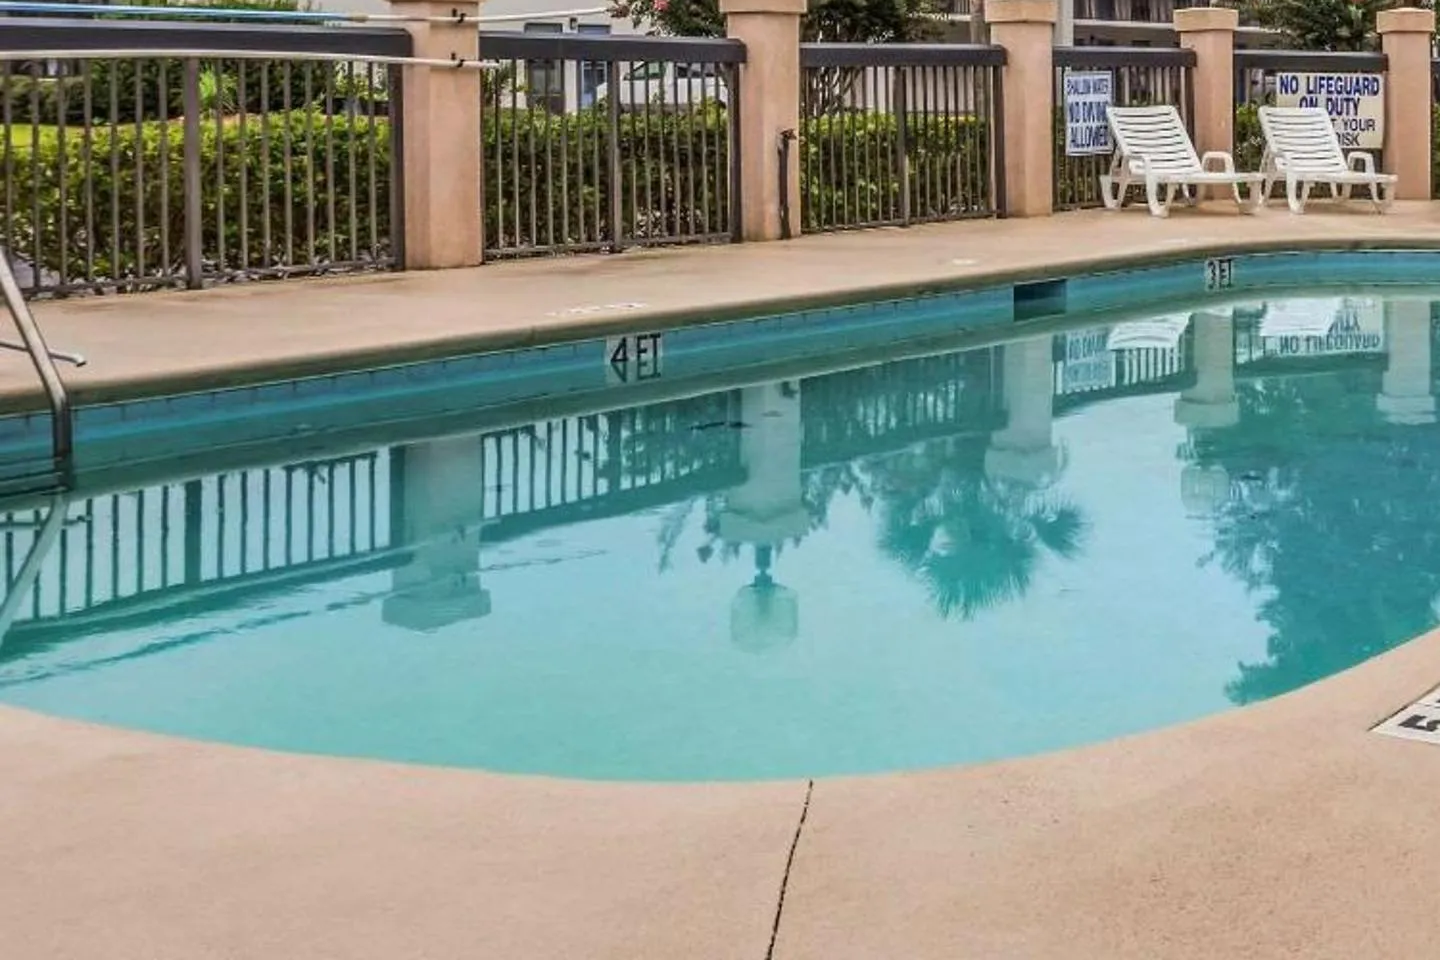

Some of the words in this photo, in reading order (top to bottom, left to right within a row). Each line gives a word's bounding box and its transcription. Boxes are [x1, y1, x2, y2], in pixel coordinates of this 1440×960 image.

[1279, 75, 1299, 94] NO
[1306, 76, 1380, 96] LIFEGUARD
[1069, 101, 1081, 123] NO
[1326, 97, 1360, 115] DUTY
[1342, 119, 1376, 131] YOUR
[1070, 126, 1108, 147] ALLOWED
[610, 336, 629, 366] 4
